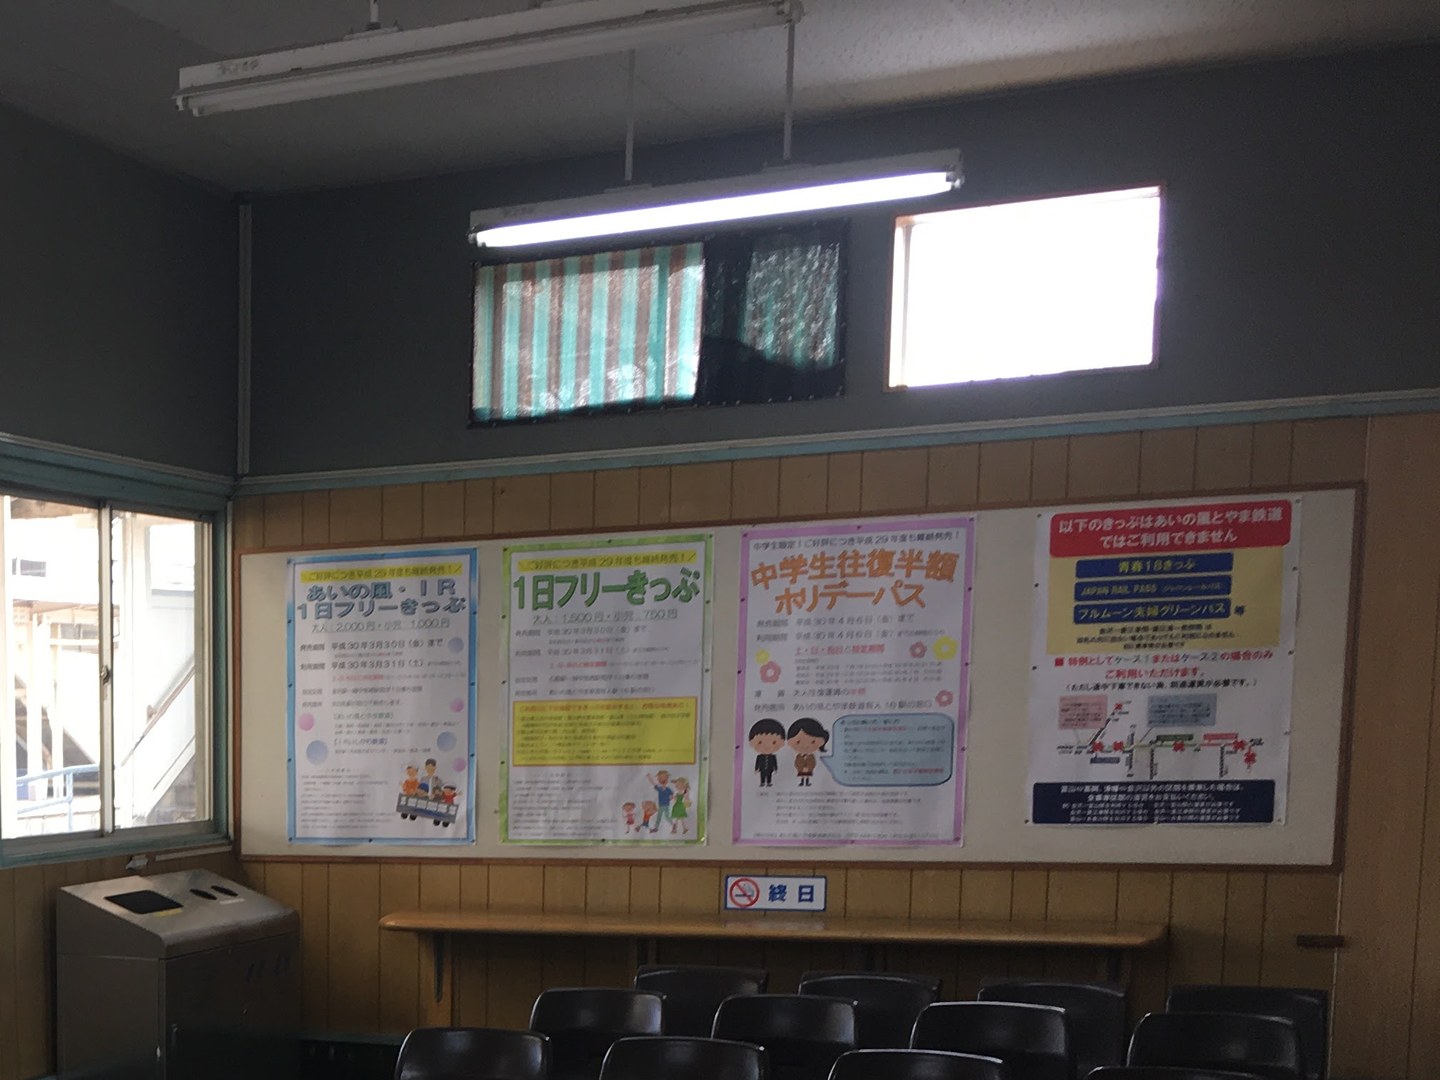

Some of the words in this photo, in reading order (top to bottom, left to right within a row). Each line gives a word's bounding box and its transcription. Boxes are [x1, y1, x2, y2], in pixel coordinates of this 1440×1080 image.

[1059, 506, 1284, 534] 以下のきっぷはあいの風とやま鉄道
[1100, 528, 1238, 549] ではご利用できません
[751, 548, 960, 590] 中学生往復半額
[1117, 558, 1196, 574] 青春18きっぷ
[512, 566, 701, 611] 1日フリーきっぷ
[775, 579, 926, 616] ホリデーパス
[297, 597, 467, 620] 1日フリーきっぷ
[1078, 602, 1226, 620] フルムーン夫婦グリーンパス
[768, 884, 815, 903] 終日
